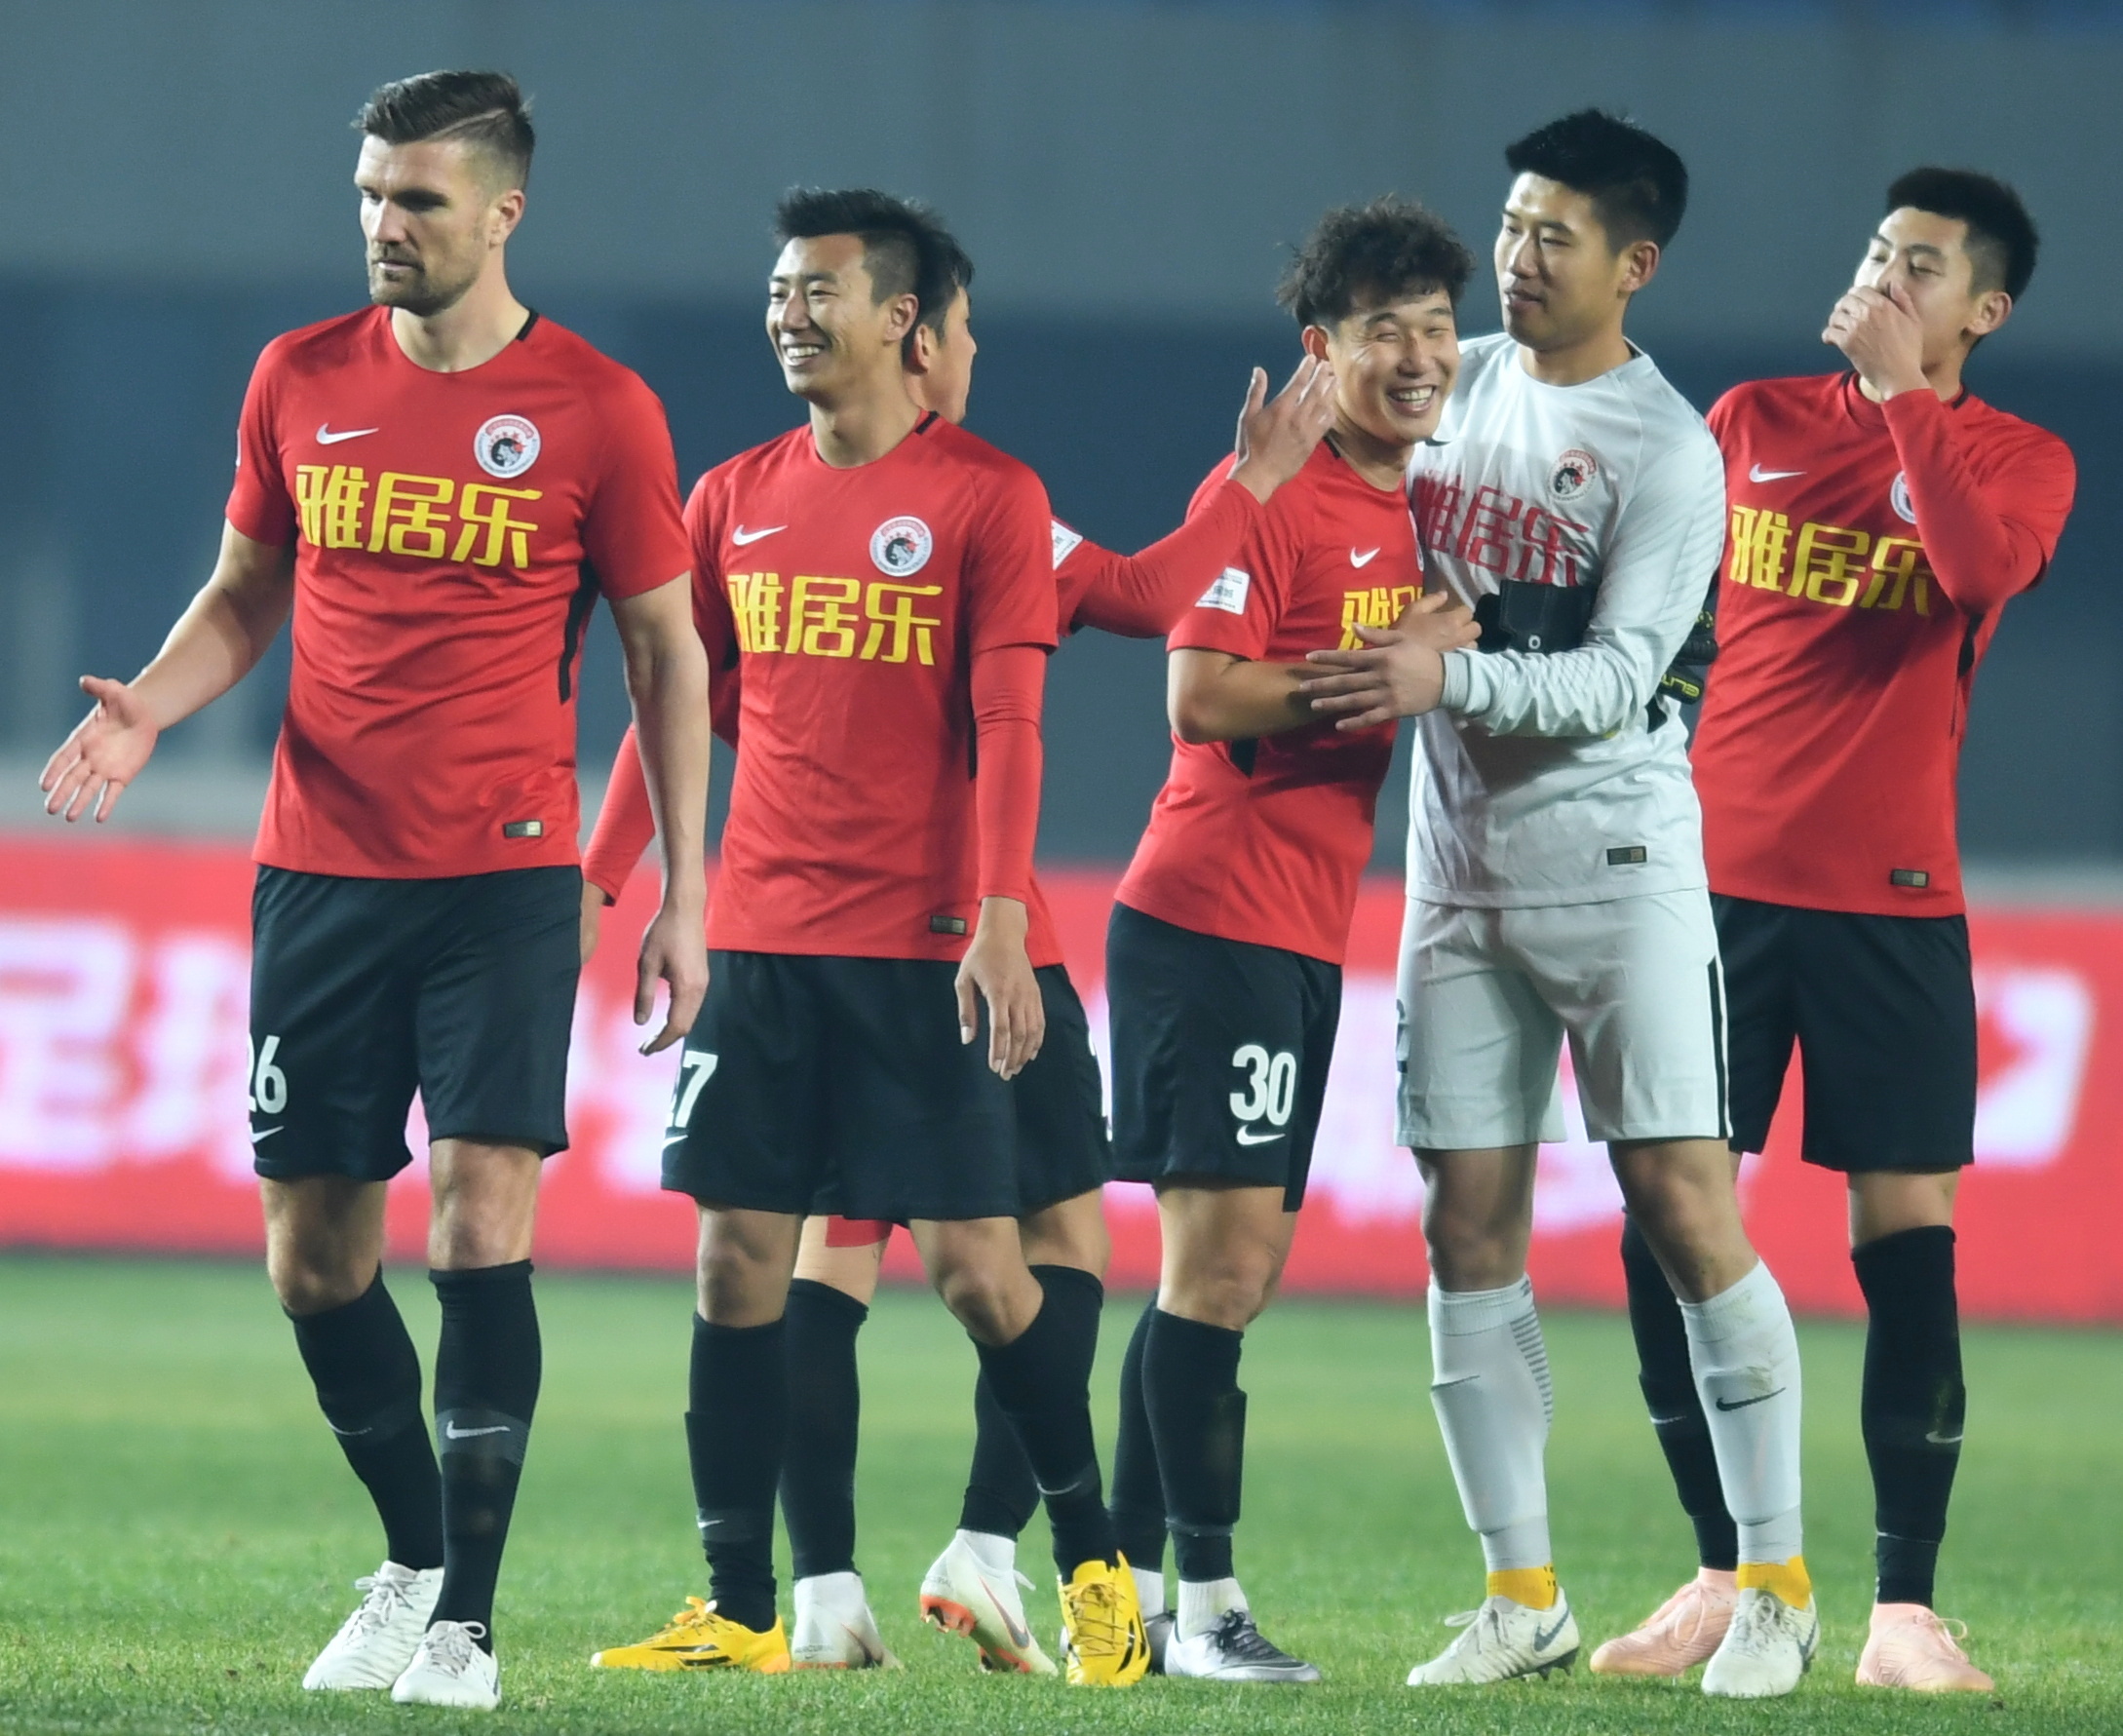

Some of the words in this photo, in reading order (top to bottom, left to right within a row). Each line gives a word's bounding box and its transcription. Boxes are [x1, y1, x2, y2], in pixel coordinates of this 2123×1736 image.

[296, 465, 543, 568] 雅居乐
[1411, 469, 1590, 588] 雅居乐
[1729, 504, 1933, 617] 雅居乐
[727, 572, 944, 666] 雅居乐
[249, 1034, 288, 1114] 6
[666, 1050, 719, 1128] 7
[1229, 1044, 1297, 1126] 30
